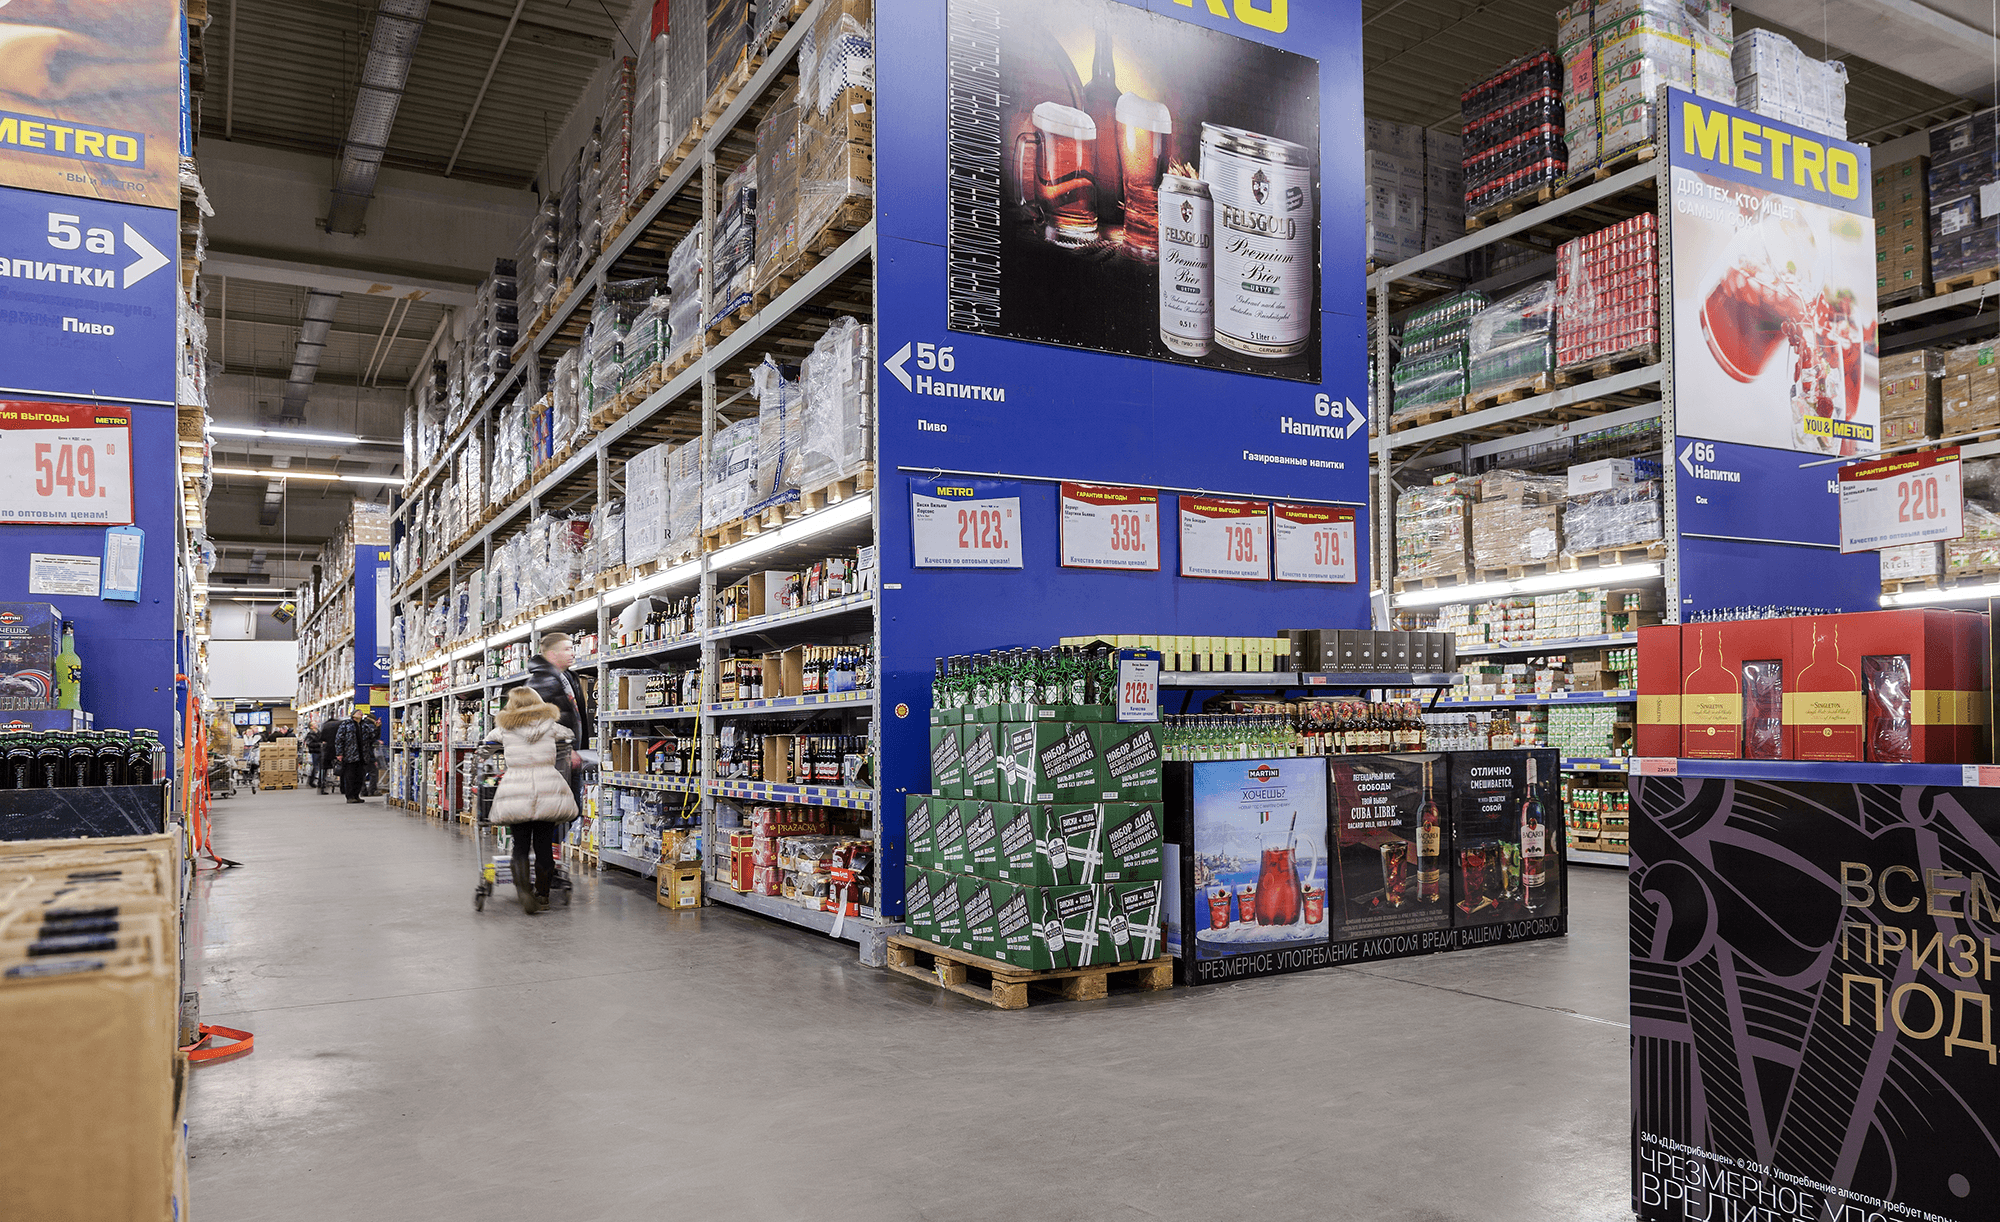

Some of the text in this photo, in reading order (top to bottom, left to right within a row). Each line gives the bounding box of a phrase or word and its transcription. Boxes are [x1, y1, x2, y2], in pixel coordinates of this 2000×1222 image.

[950, 68, 1010, 121] ВРЕДИТ
[0, 117, 138, 162] METRO
[950, 119, 1001, 177] АЛКОГОЛЯ
[1683, 101, 1859, 200] METRO
[100, 177, 145, 192] METRO
[1677, 177, 1795, 220] ДЛЯ ТЕХ, КТО ИЩЕТ
[950, 172, 1001, 258] УПОТРЕБЛЕНИЕ
[1222, 204, 1296, 240] FELSGOLD
[1677, 201, 1753, 228] САМЫЙ СОК
[47, 212, 115, 255] 5а
[1165, 226, 1210, 249] FELSGOLD
[1165, 248, 1208, 270] Premium
[1225, 235, 1294, 264] Premium
[1174, 267, 1200, 285] Bier
[1241, 260, 1281, 284] Bier
[950, 253, 1001, 328] ЧРЕЗМЕРНОЕ
[62, 316, 115, 336] Пиво
[1250, 331, 1255, 339] 5
[916, 342, 955, 373] 5б
[916, 375, 1006, 403] Напитки
[1314, 392, 1344, 419] 6а
[20, 412, 70, 423] ВЫГОДЫ
[95, 417, 128, 425] METRO
[917, 419, 948, 432] Пиво
[1280, 416, 1344, 440] Напитки
[1805, 418, 1872, 440] YOU & METRO
[106, 443, 115, 455] 00
[1242, 450, 1345, 470] Газированные напитки
[1694, 442, 1715, 463] 6б
[1936, 454, 1959, 462] METRO
[35, 442, 106, 498] 549.
[1695, 464, 1741, 482] Напитки
[1855, 460, 1919, 477] ГАРАНТИЯ ВЫГОДЫ
[936, 486, 974, 497] METRO
[1076, 491, 1103, 499] ГАРАНТИЯ
[1695, 495, 1708, 505] Сок
[1898, 477, 1946, 523] 220.
[71, 511, 108, 519] ценам!
[1193, 504, 1218, 512] ГАРАНТИЯ
[958, 509, 1009, 549] 2123.
[1110, 513, 1146, 552] 339.
[1849, 536, 1878, 544] Качество
[1889, 530, 1921, 539] оптовым
[1922, 526, 1948, 535] ценам!
[1225, 526, 1258, 562] 739.
[1314, 531, 1344, 566] 379.
[1070, 556, 1094, 564] Качество
[1188, 566, 1211, 574] Качество
[1882, 560, 1910, 570] Rich
[1125, 681, 1150, 704] 2123.
[1041, 730, 1088, 763] НАБОР ДЛЯ
[1106, 730, 1151, 762] НАБОР ДЛЯ
[1046, 749, 1094, 779] БОЛЕЛЬЩИКА
[1111, 749, 1158, 778] БОЛЕЛЬЩИКА
[1470, 766, 1511, 776] ОТЛИЧНО
[1242, 789, 1286, 800] ХОЧЕШЬ?
[1357, 783, 1391, 791] СВОБОДЫ
[1470, 779, 1514, 789] СМЕШИВАЕТСЯ,
[1361, 796, 1372, 805] ТВОЙ
[1481, 804, 1502, 812] СОБОЙ
[1351, 806, 1372, 820] CUBA
[1108, 810, 1153, 842] НАБОР ДЛЯ
[1347, 821, 1364, 829] BACARDI
[1522, 830, 1544, 839] BACARDI
[1113, 828, 1159, 858] БОЛЕЛЬЩИКА
[1197, 916, 1560, 980] ЧРЕЗМЕРНОЕ УПОТРЕБЛЕНИЕ АЛКОГОЛЯ ВРЕДИТ ВАШЕМУ ЗДОРОВЬЮ
[1641, 1131, 1657, 1144] ЗАО
[1736, 1157, 1745, 1169] ©
[1746, 1160, 1772, 1177] 2014.
[1773, 1168, 1837, 1196] Употребление
[1838, 1187, 1881, 1207] алкоголя
[1882, 1199, 1922, 1220] требует
[1641, 1147, 1815, 1221] ЧРЕЗМЕРНОЕ
